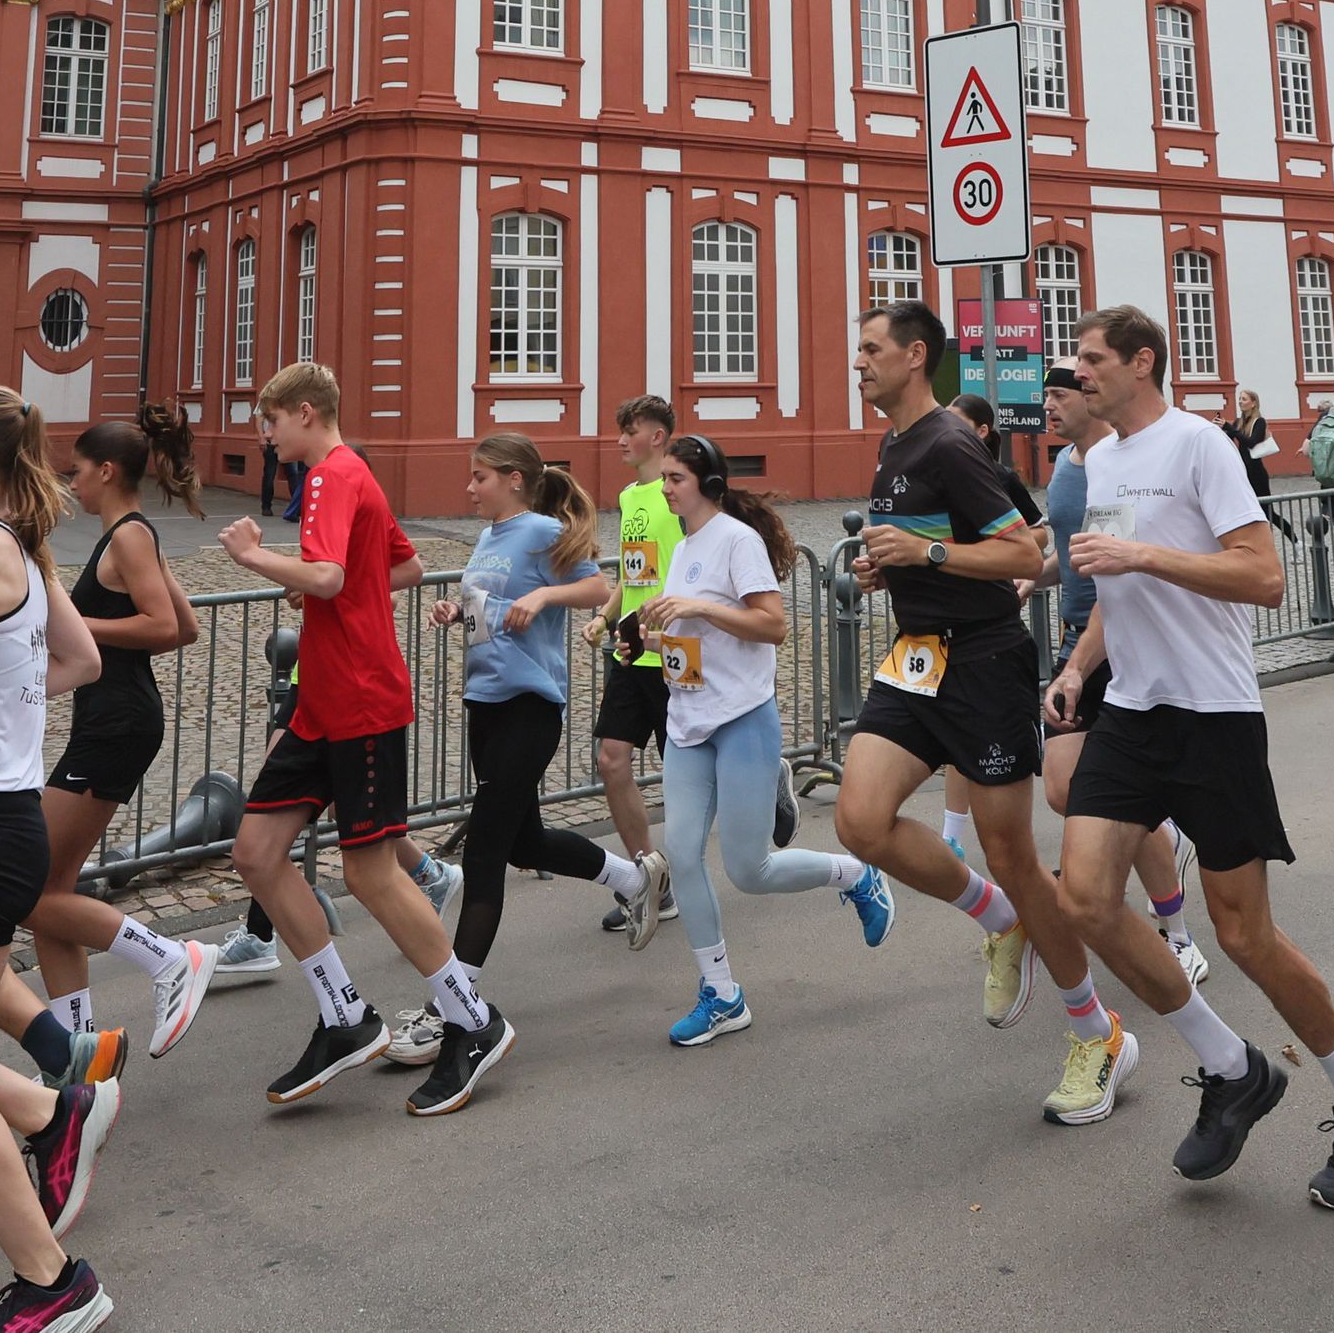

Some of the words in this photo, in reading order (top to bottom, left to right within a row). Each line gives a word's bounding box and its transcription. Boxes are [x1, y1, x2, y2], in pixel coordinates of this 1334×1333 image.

[963, 177, 993, 209] 30
[962, 325, 1038, 338] VERUNFT
[868, 498, 893, 512] ACH3
[625, 558, 642, 570] 141
[666, 654, 681, 670] 22
[908, 656, 925, 673] 58
